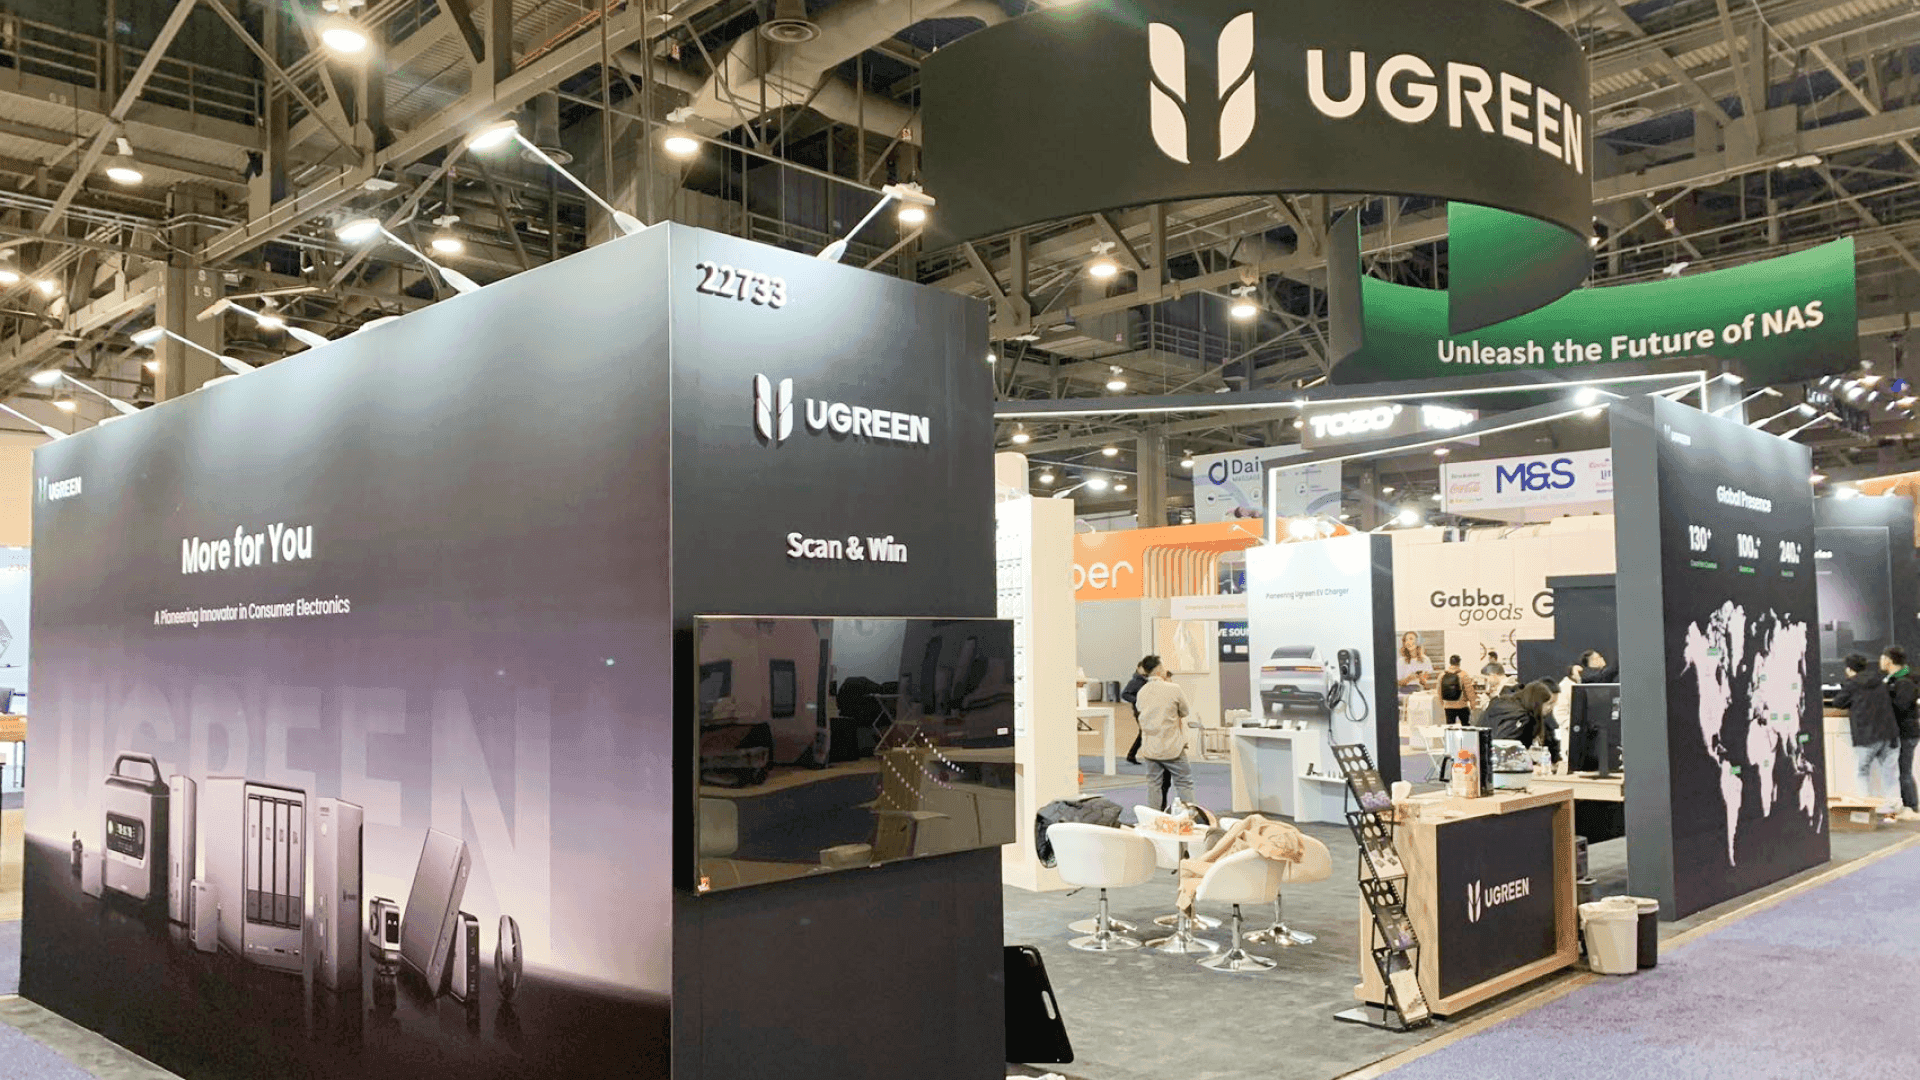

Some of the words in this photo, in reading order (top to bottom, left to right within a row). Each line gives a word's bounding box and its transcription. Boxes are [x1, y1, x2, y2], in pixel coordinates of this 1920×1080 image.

[1306, 49, 1583, 174] UGREEN
[696, 260, 787, 308] 22733
[1437, 338, 1545, 365] Unleash
[1553, 338, 1602, 364] the
[1610, 326, 1714, 360] Future
[1723, 314, 1754, 344] of
[1761, 300, 1825, 337] NAS
[805, 398, 930, 445] UGREEN
[1309, 405, 1396, 438] TOZO
[1231, 456, 1263, 474] Dai
[1496, 458, 1576, 494] M&S
[48, 476, 82, 501] UGREEN
[1716, 484, 1741, 507] Global
[1742, 490, 1772, 514] Presence
[181, 536, 230, 574] More
[234, 525, 264, 567] for
[267, 522, 313, 563] You
[787, 532, 843, 560] Scan
[846, 535, 864, 561] &
[867, 535, 907, 563] Win
[1324, 587, 1349, 597] Charger
[1430, 588, 1505, 608] Gabba
[154, 610, 160, 626] A
[160, 607, 199, 629] Pioneering
[199, 604, 238, 623] Innovator
[238, 603, 247, 620] in
[248, 602, 296, 620] Consumer
[296, 594, 351, 616] Electronics
[1458, 604, 1524, 627] goods
[1228, 627, 1249, 637] SOU
[1484, 876, 1530, 908] UGREEN
